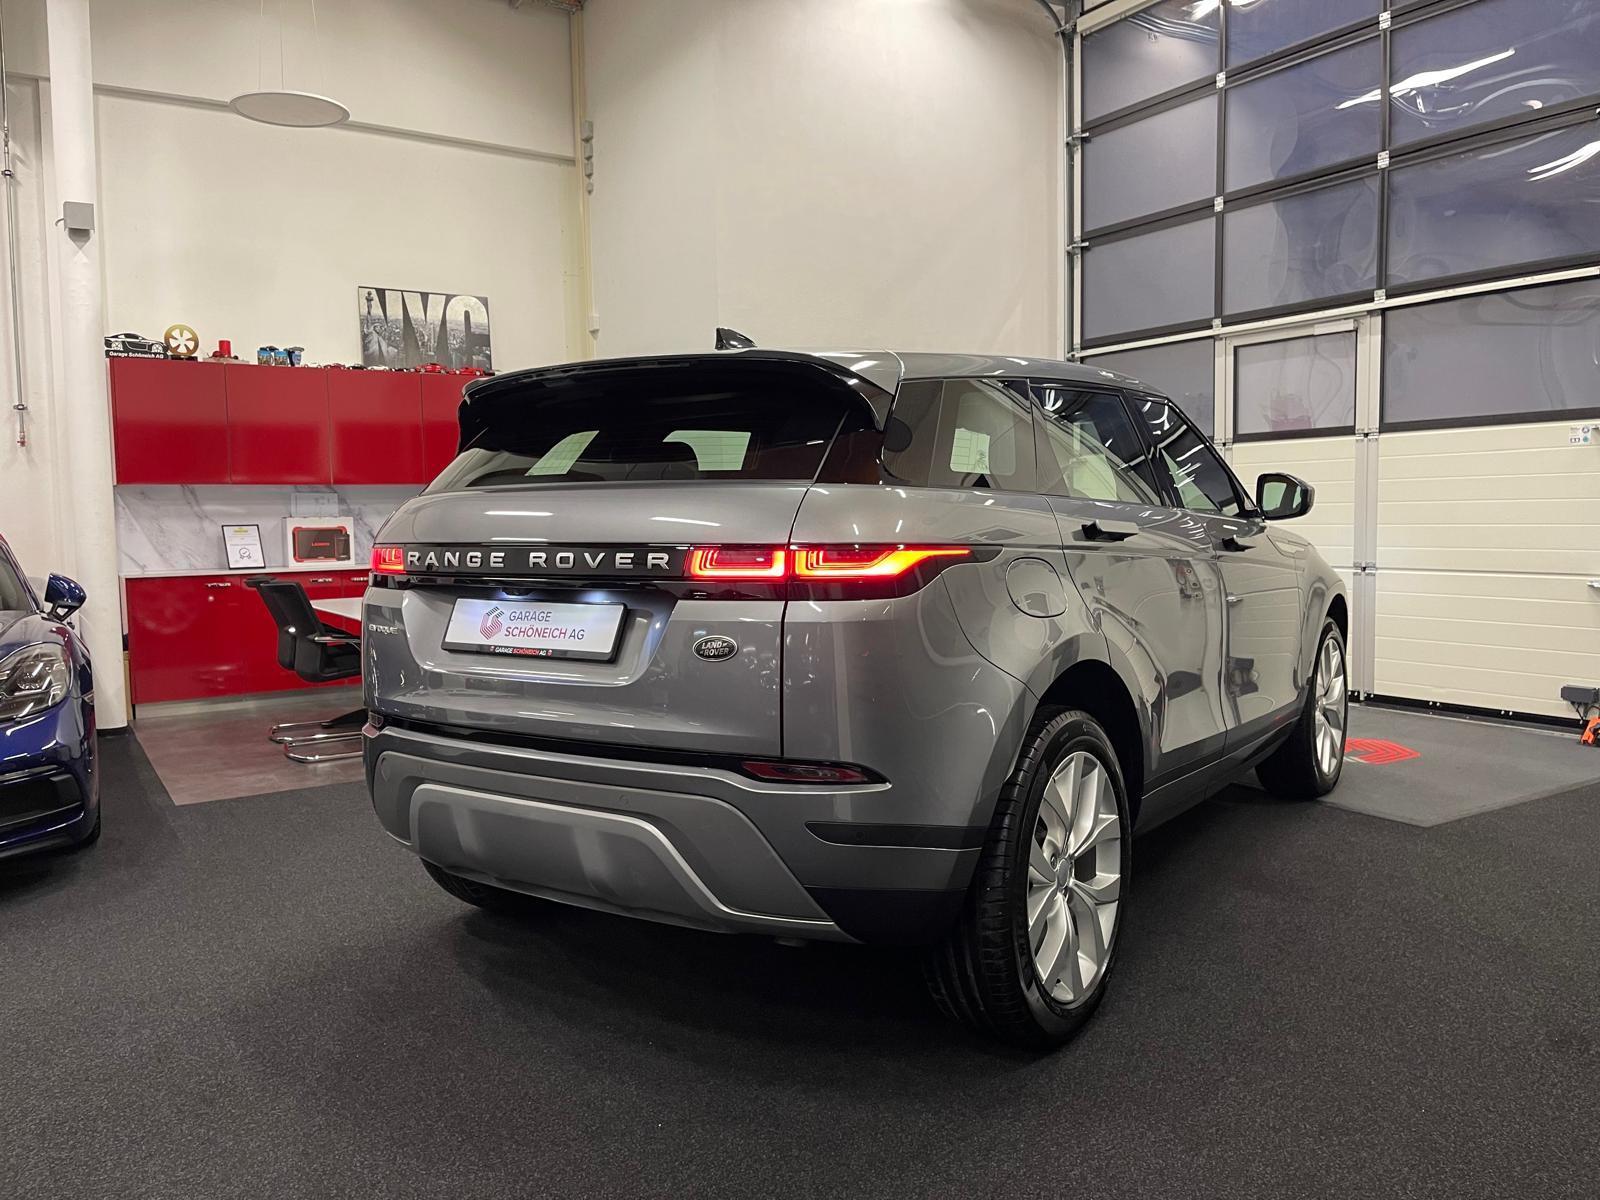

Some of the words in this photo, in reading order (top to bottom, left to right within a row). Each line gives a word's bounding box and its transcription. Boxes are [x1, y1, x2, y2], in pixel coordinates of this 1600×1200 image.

[358, 287, 490, 370] NYC
[407, 551, 505, 568] RANGE
[529, 552, 670, 570] ROVER
[509, 611, 552, 622] GARAGE
[504, 625, 567, 639] SCHÖNEICH
[568, 629, 585, 640] AG
[702, 641, 722, 649] LAND
[704, 648, 729, 656] ROVER
